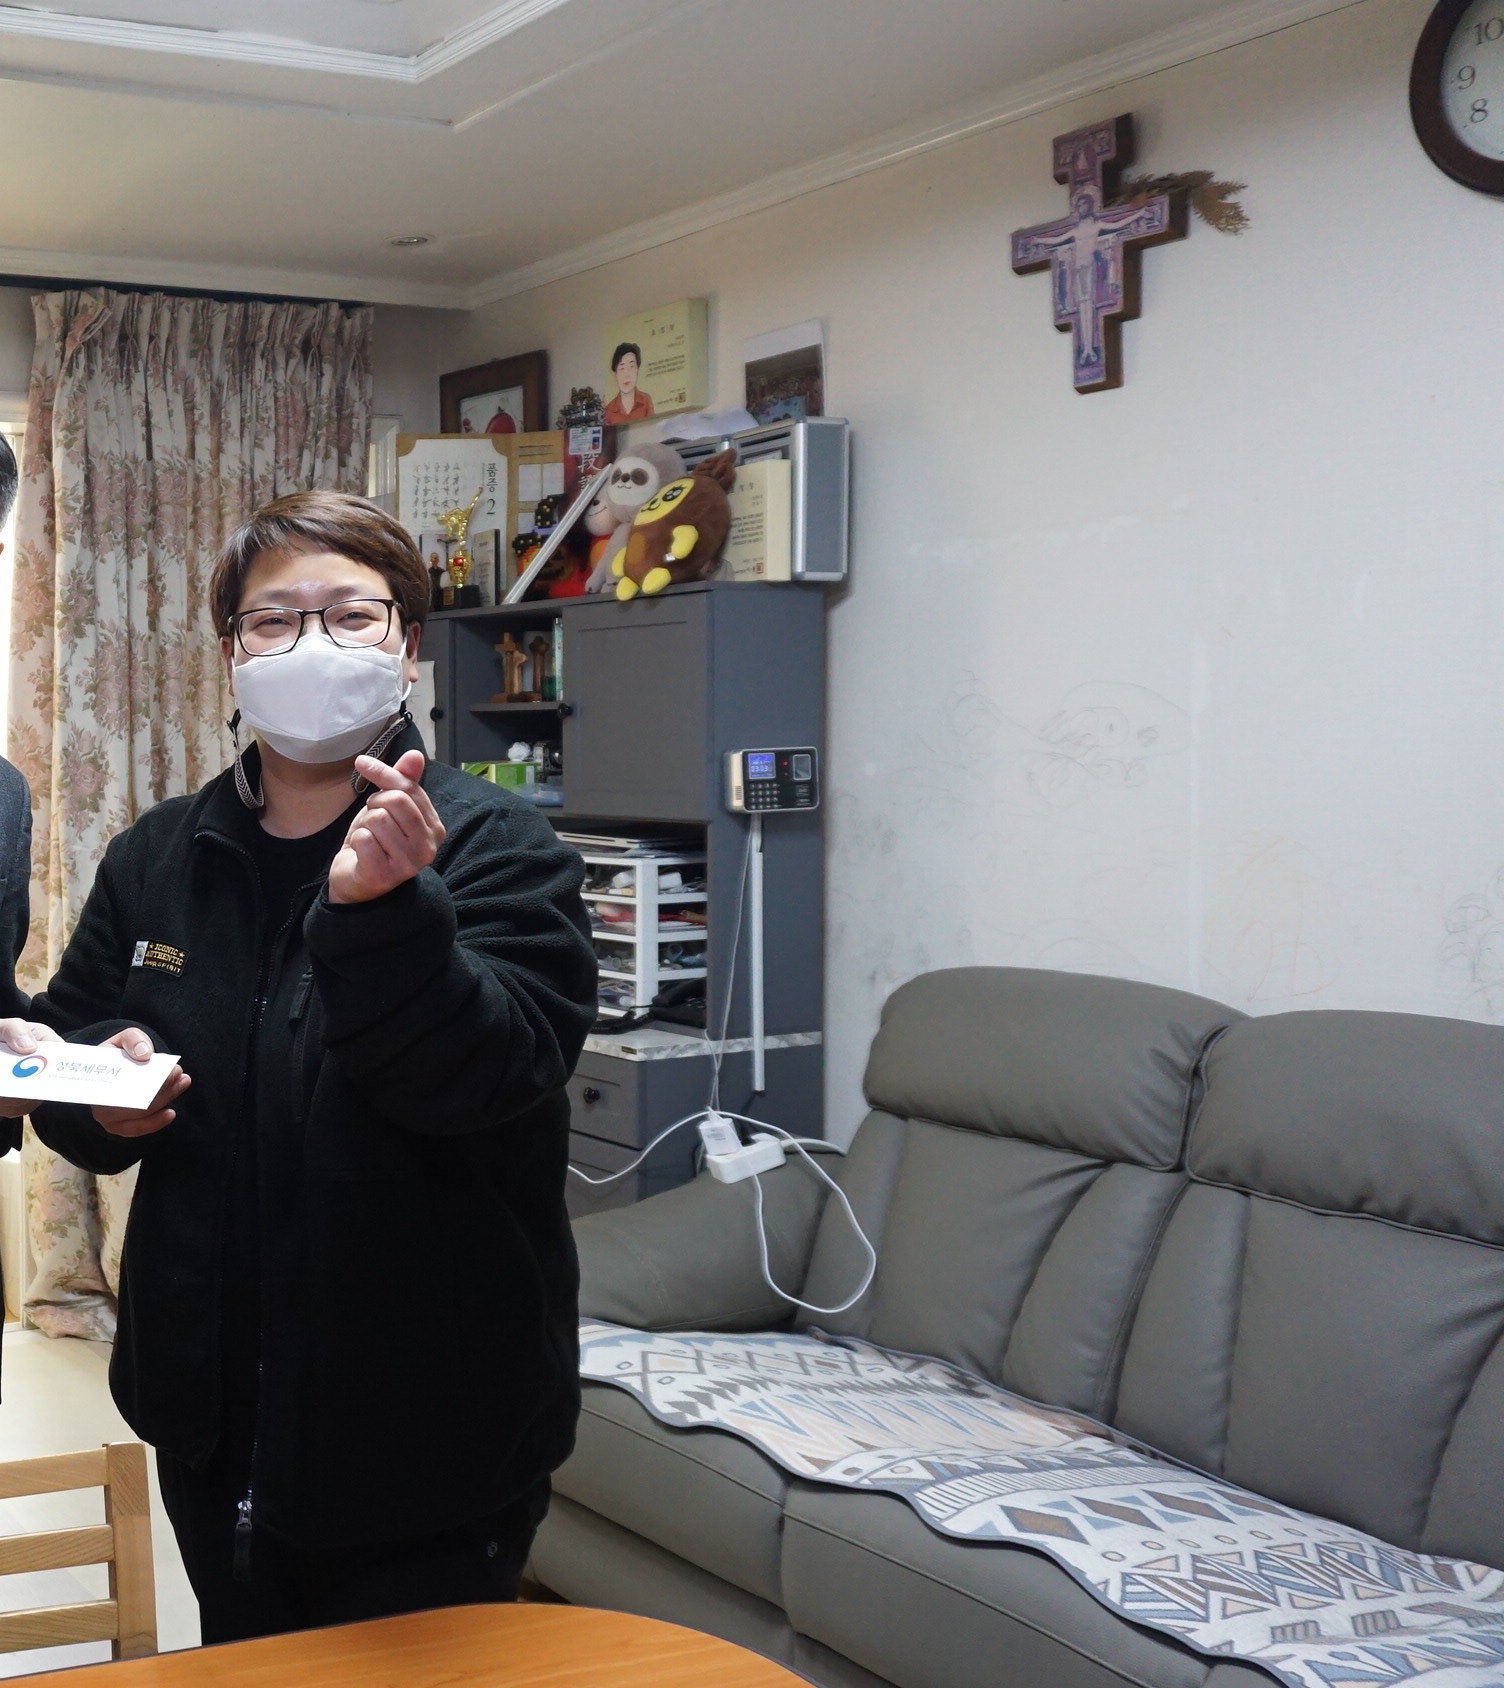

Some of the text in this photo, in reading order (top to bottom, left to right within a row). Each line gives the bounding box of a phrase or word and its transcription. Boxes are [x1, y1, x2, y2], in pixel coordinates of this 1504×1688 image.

[1474, 17, 1504, 46] 10
[1457, 65, 1476, 90] 9
[1470, 98, 1488, 123] 8
[486, 462, 498, 515] 품증 2
[146, 950, 184, 966] AUTHENTIC
[155, 943, 179, 956] ICONIC
